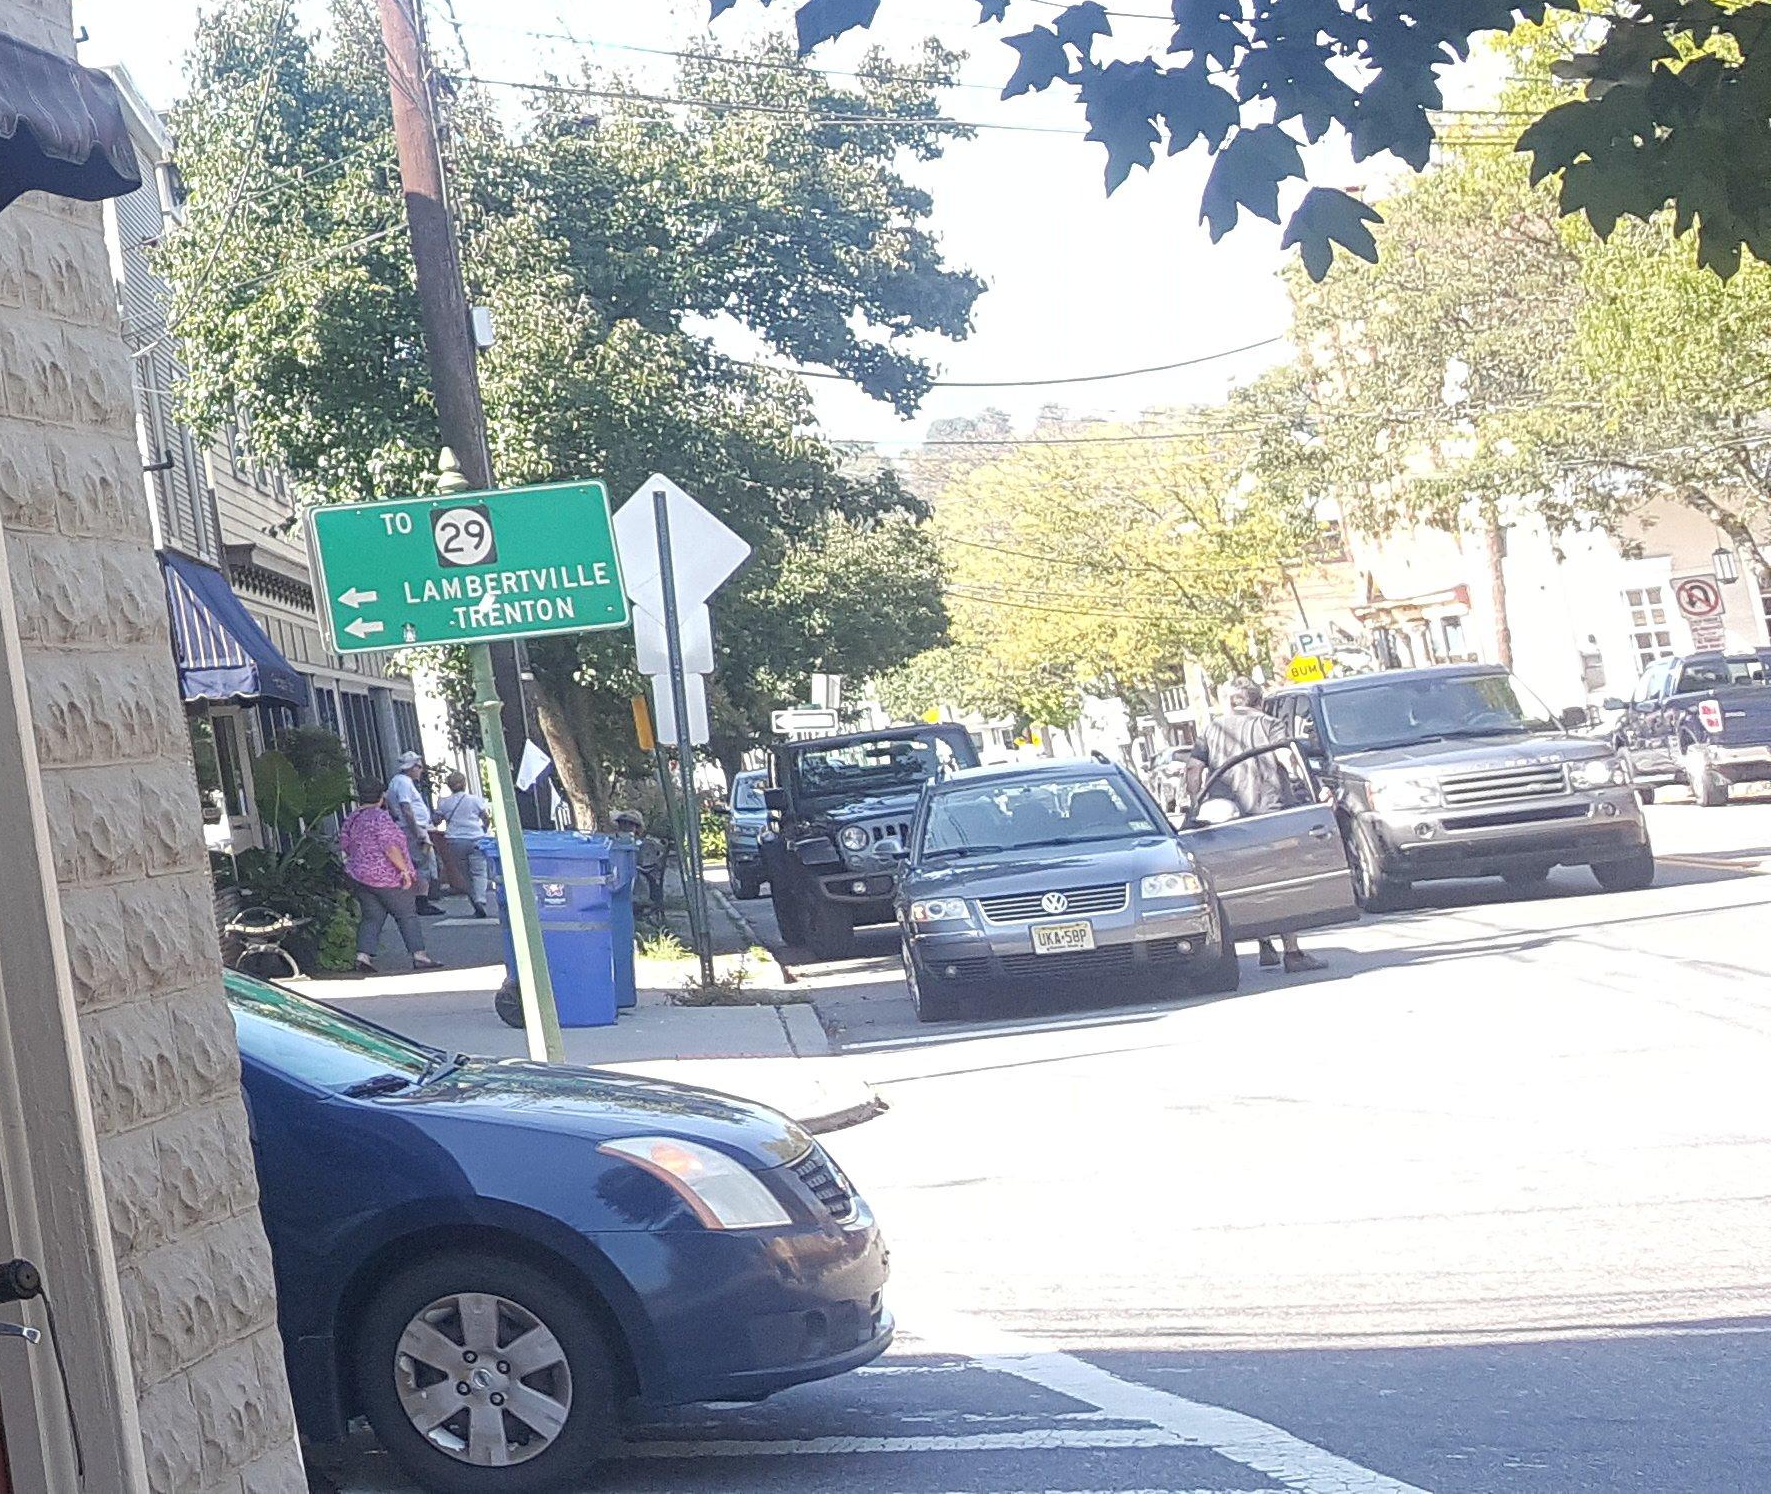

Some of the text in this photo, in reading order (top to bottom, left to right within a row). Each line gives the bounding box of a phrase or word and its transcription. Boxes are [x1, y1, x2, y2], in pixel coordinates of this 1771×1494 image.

[380, 512, 413, 536] TO
[440, 519, 486, 554] 29
[404, 562, 611, 605] LAMBERTVILLE
[452, 596, 576, 630] TRENTON
[1299, 633, 1314, 653] P
[1291, 663, 1320, 678] BUM
